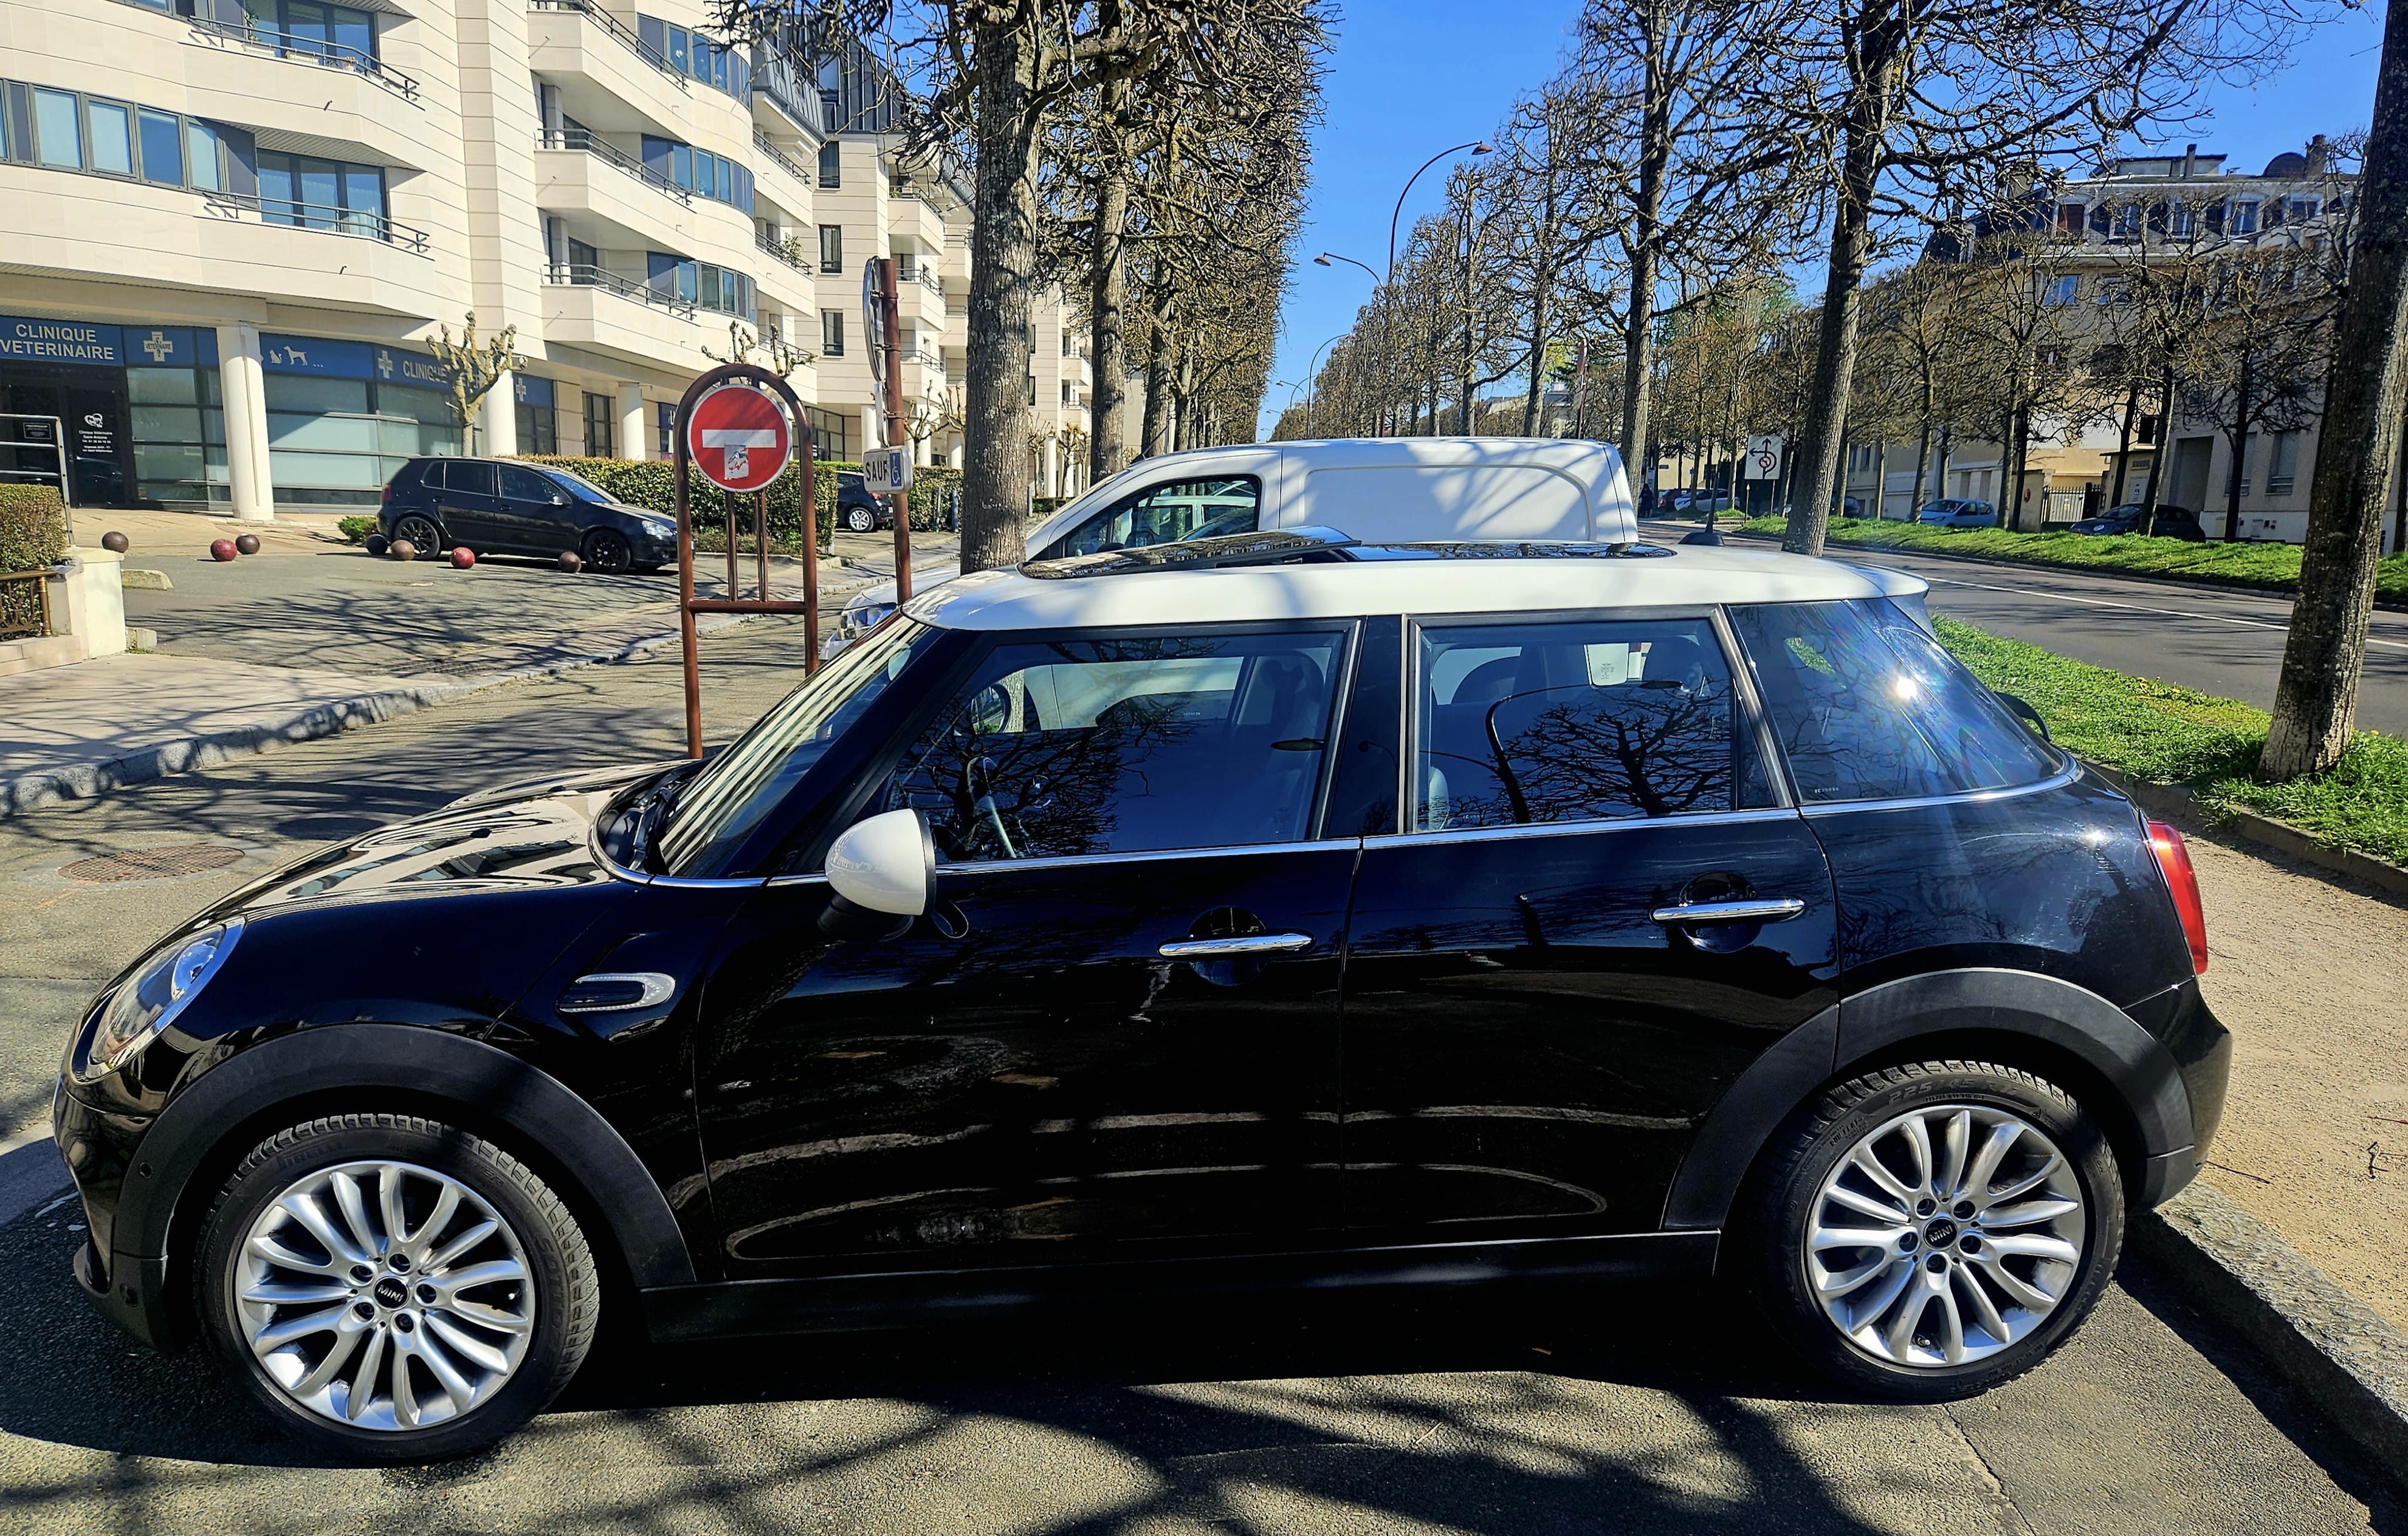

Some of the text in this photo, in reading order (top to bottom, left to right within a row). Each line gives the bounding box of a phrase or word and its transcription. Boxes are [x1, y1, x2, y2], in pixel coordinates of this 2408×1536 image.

[16, 324, 97, 343] CLINIQUE
[0, 339, 114, 360] VETERINAIRE
[403, 360, 449, 384] CLINIQUE
[865, 460, 888, 482] SAUF
[1928, 1224, 1953, 1243] MINI
[377, 1284, 404, 1302] MINI
